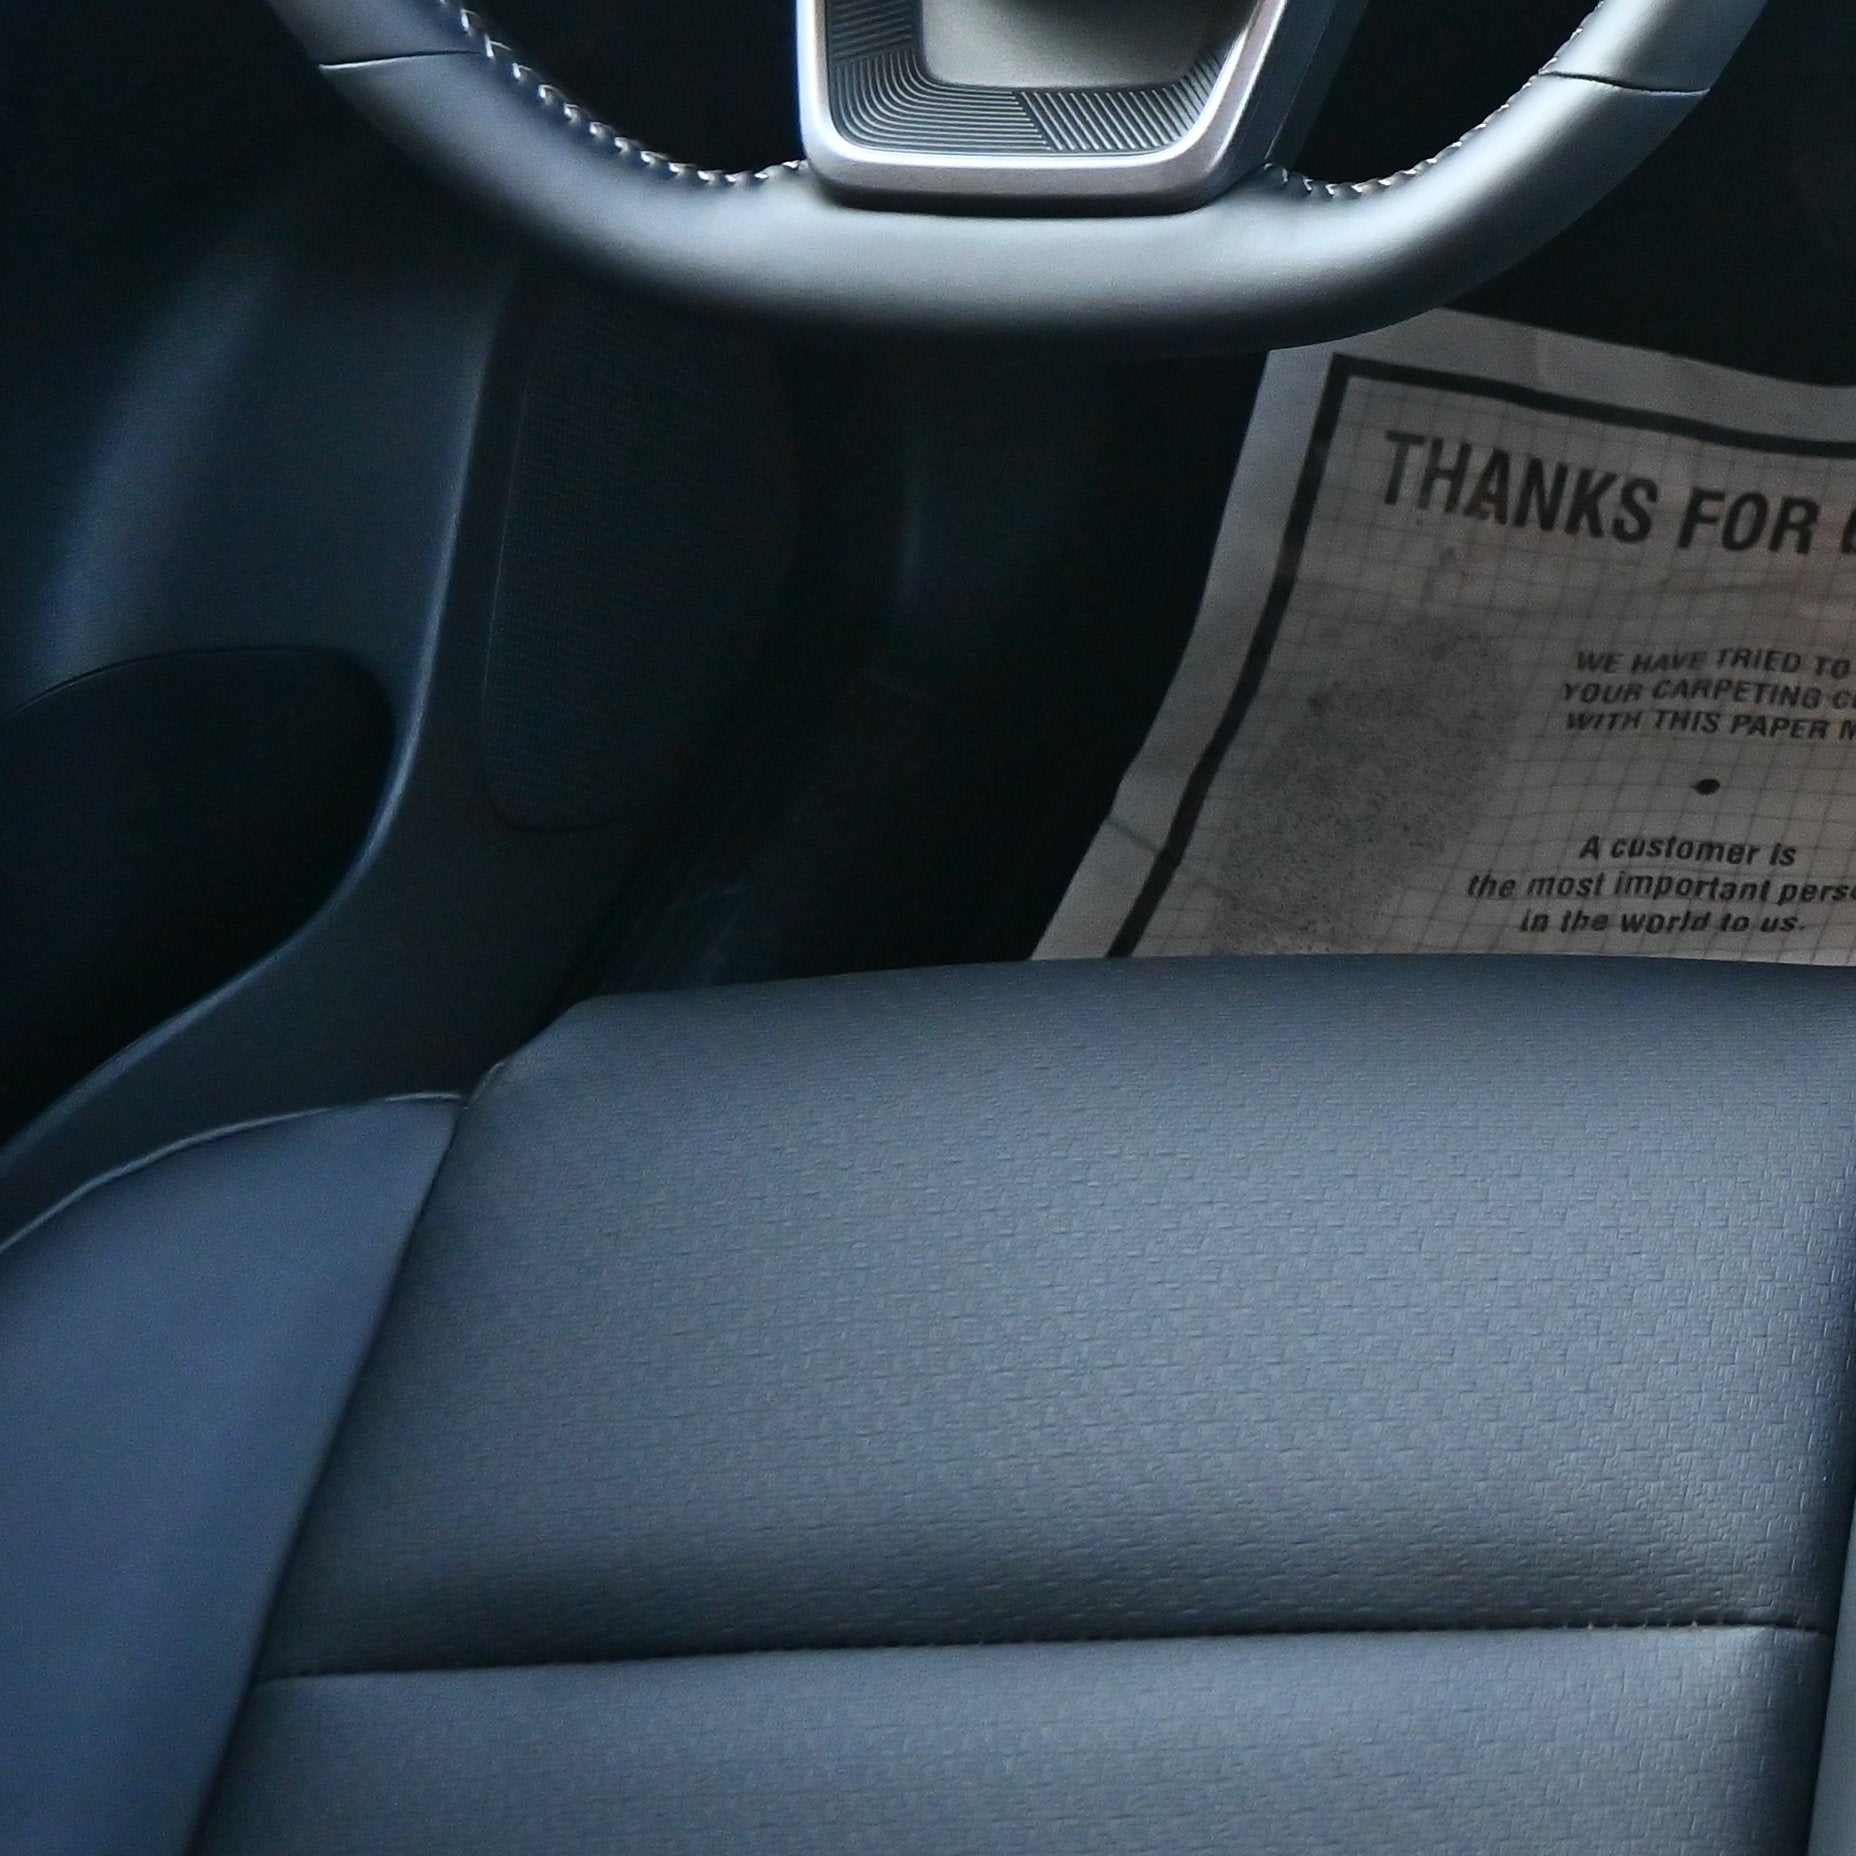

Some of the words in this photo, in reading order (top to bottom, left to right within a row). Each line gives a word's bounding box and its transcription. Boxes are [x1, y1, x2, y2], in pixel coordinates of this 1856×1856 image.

[1384, 429, 1659, 543] THANKS
[1677, 486, 1821, 554] FOR
[1577, 652, 1624, 674] WE
[1630, 651, 1708, 674] HAVE
[1716, 648, 1801, 673] TRIED
[1815, 656, 1850, 679] TO
[1564, 682, 1643, 704] YOUR
[1652, 678, 1824, 709] CARPETING
[1567, 711, 1641, 732] WITH
[1655, 710, 1720, 735] THIS
[1730, 714, 1829, 741] PAPER
[1579, 835, 1601, 861] A
[1611, 835, 1760, 865] customer
[1769, 843, 1797, 867] is
[1468, 874, 1515, 899] the
[1528, 872, 1604, 898] most
[1614, 871, 1770, 902] important
[1520, 909, 1549, 933] in
[1560, 908, 1609, 932] the
[1620, 908, 1711, 934] world
[1720, 912, 1750, 932] to
[1760, 915, 1806, 933] us.
